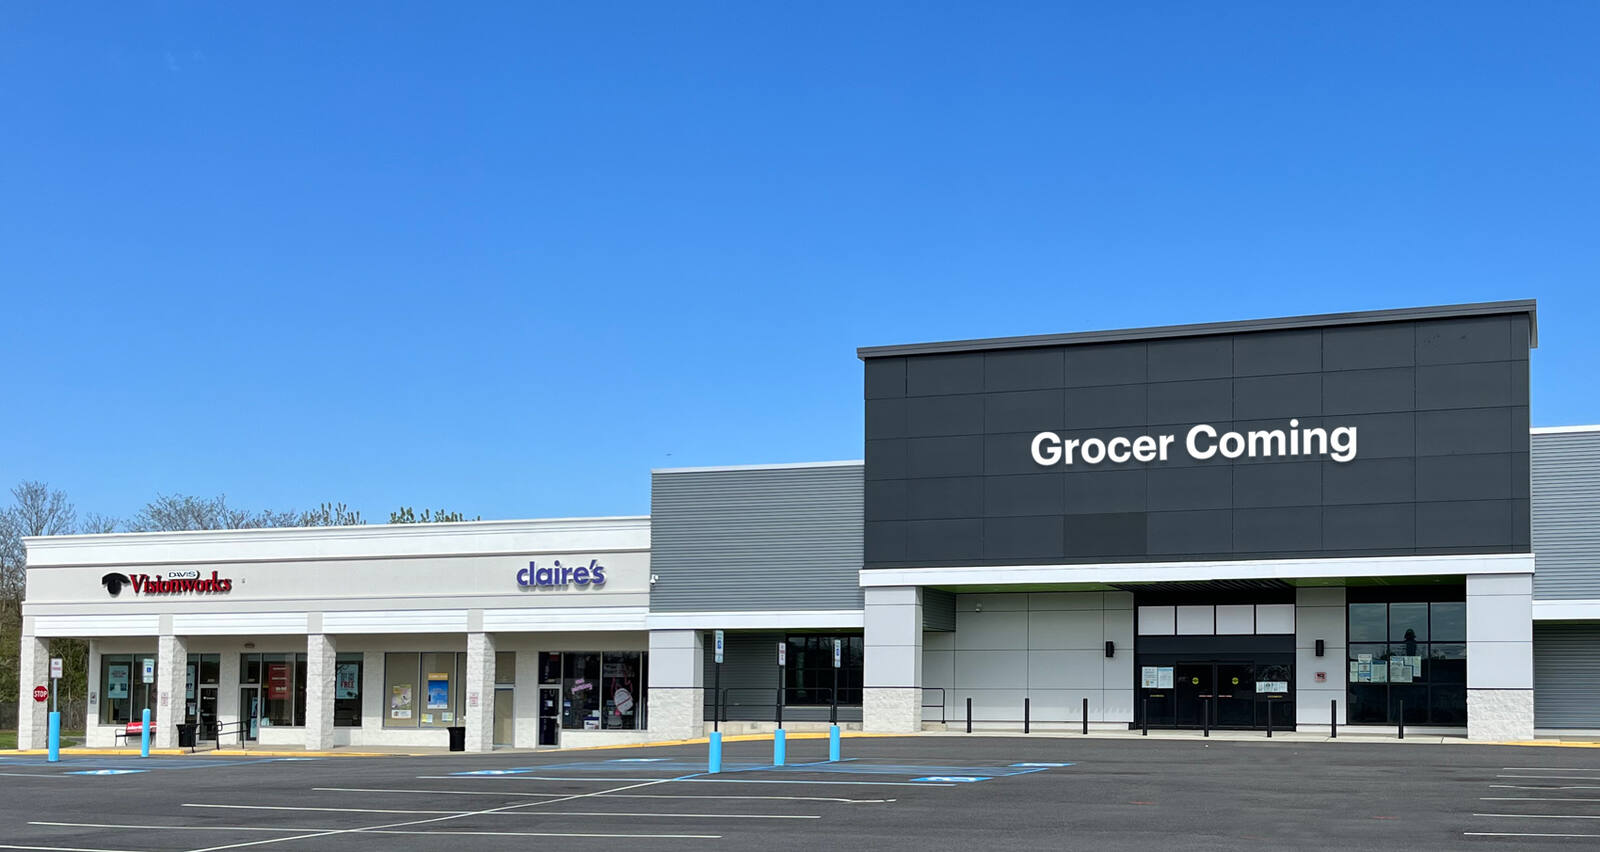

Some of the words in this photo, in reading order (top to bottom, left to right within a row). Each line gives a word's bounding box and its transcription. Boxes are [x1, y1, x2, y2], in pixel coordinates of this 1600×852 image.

[1031, 431, 1174, 466] Grocer
[1186, 419, 1357, 463] Coming
[129, 571, 232, 594] Visionworks
[516, 559, 605, 586] claire's
[34, 690, 48, 698] STOP
